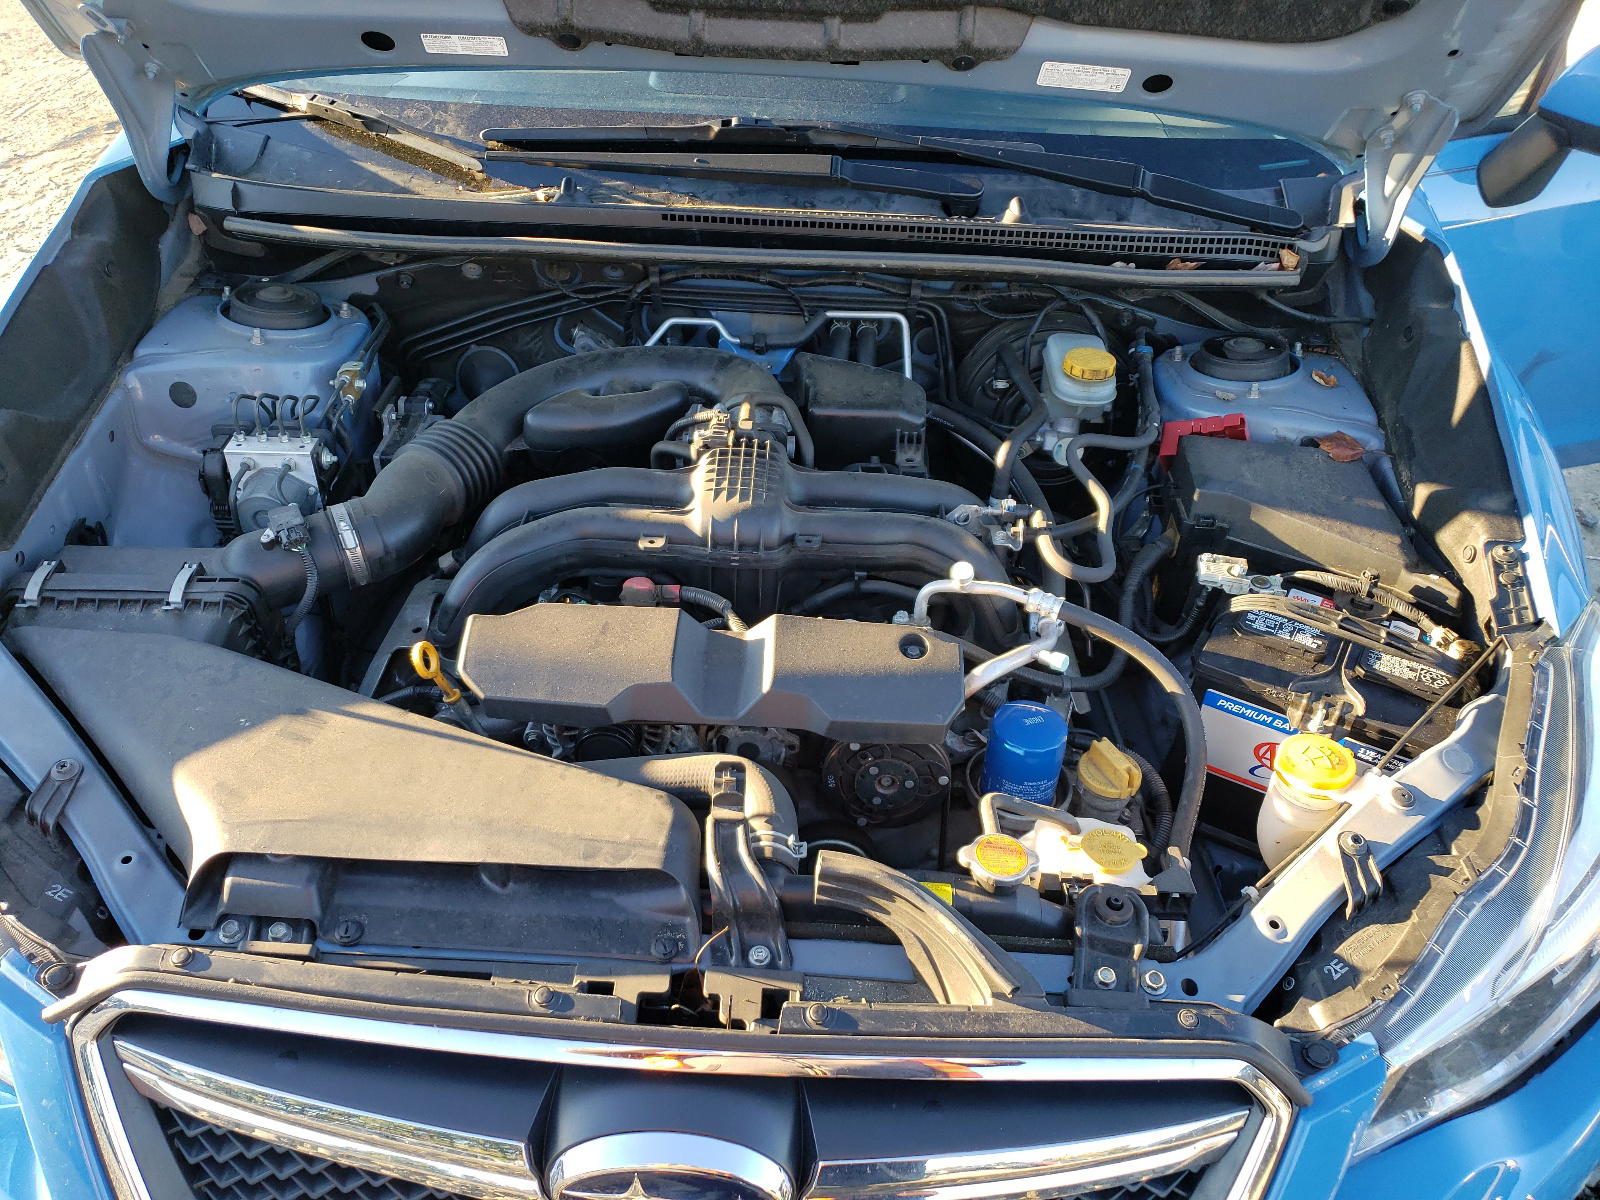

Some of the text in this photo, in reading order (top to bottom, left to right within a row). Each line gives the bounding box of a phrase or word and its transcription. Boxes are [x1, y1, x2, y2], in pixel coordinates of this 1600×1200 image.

[1217, 699, 1273, 723] PREMIUM
[44, 883, 75, 902] 2E
[1323, 958, 1350, 981] 2E
